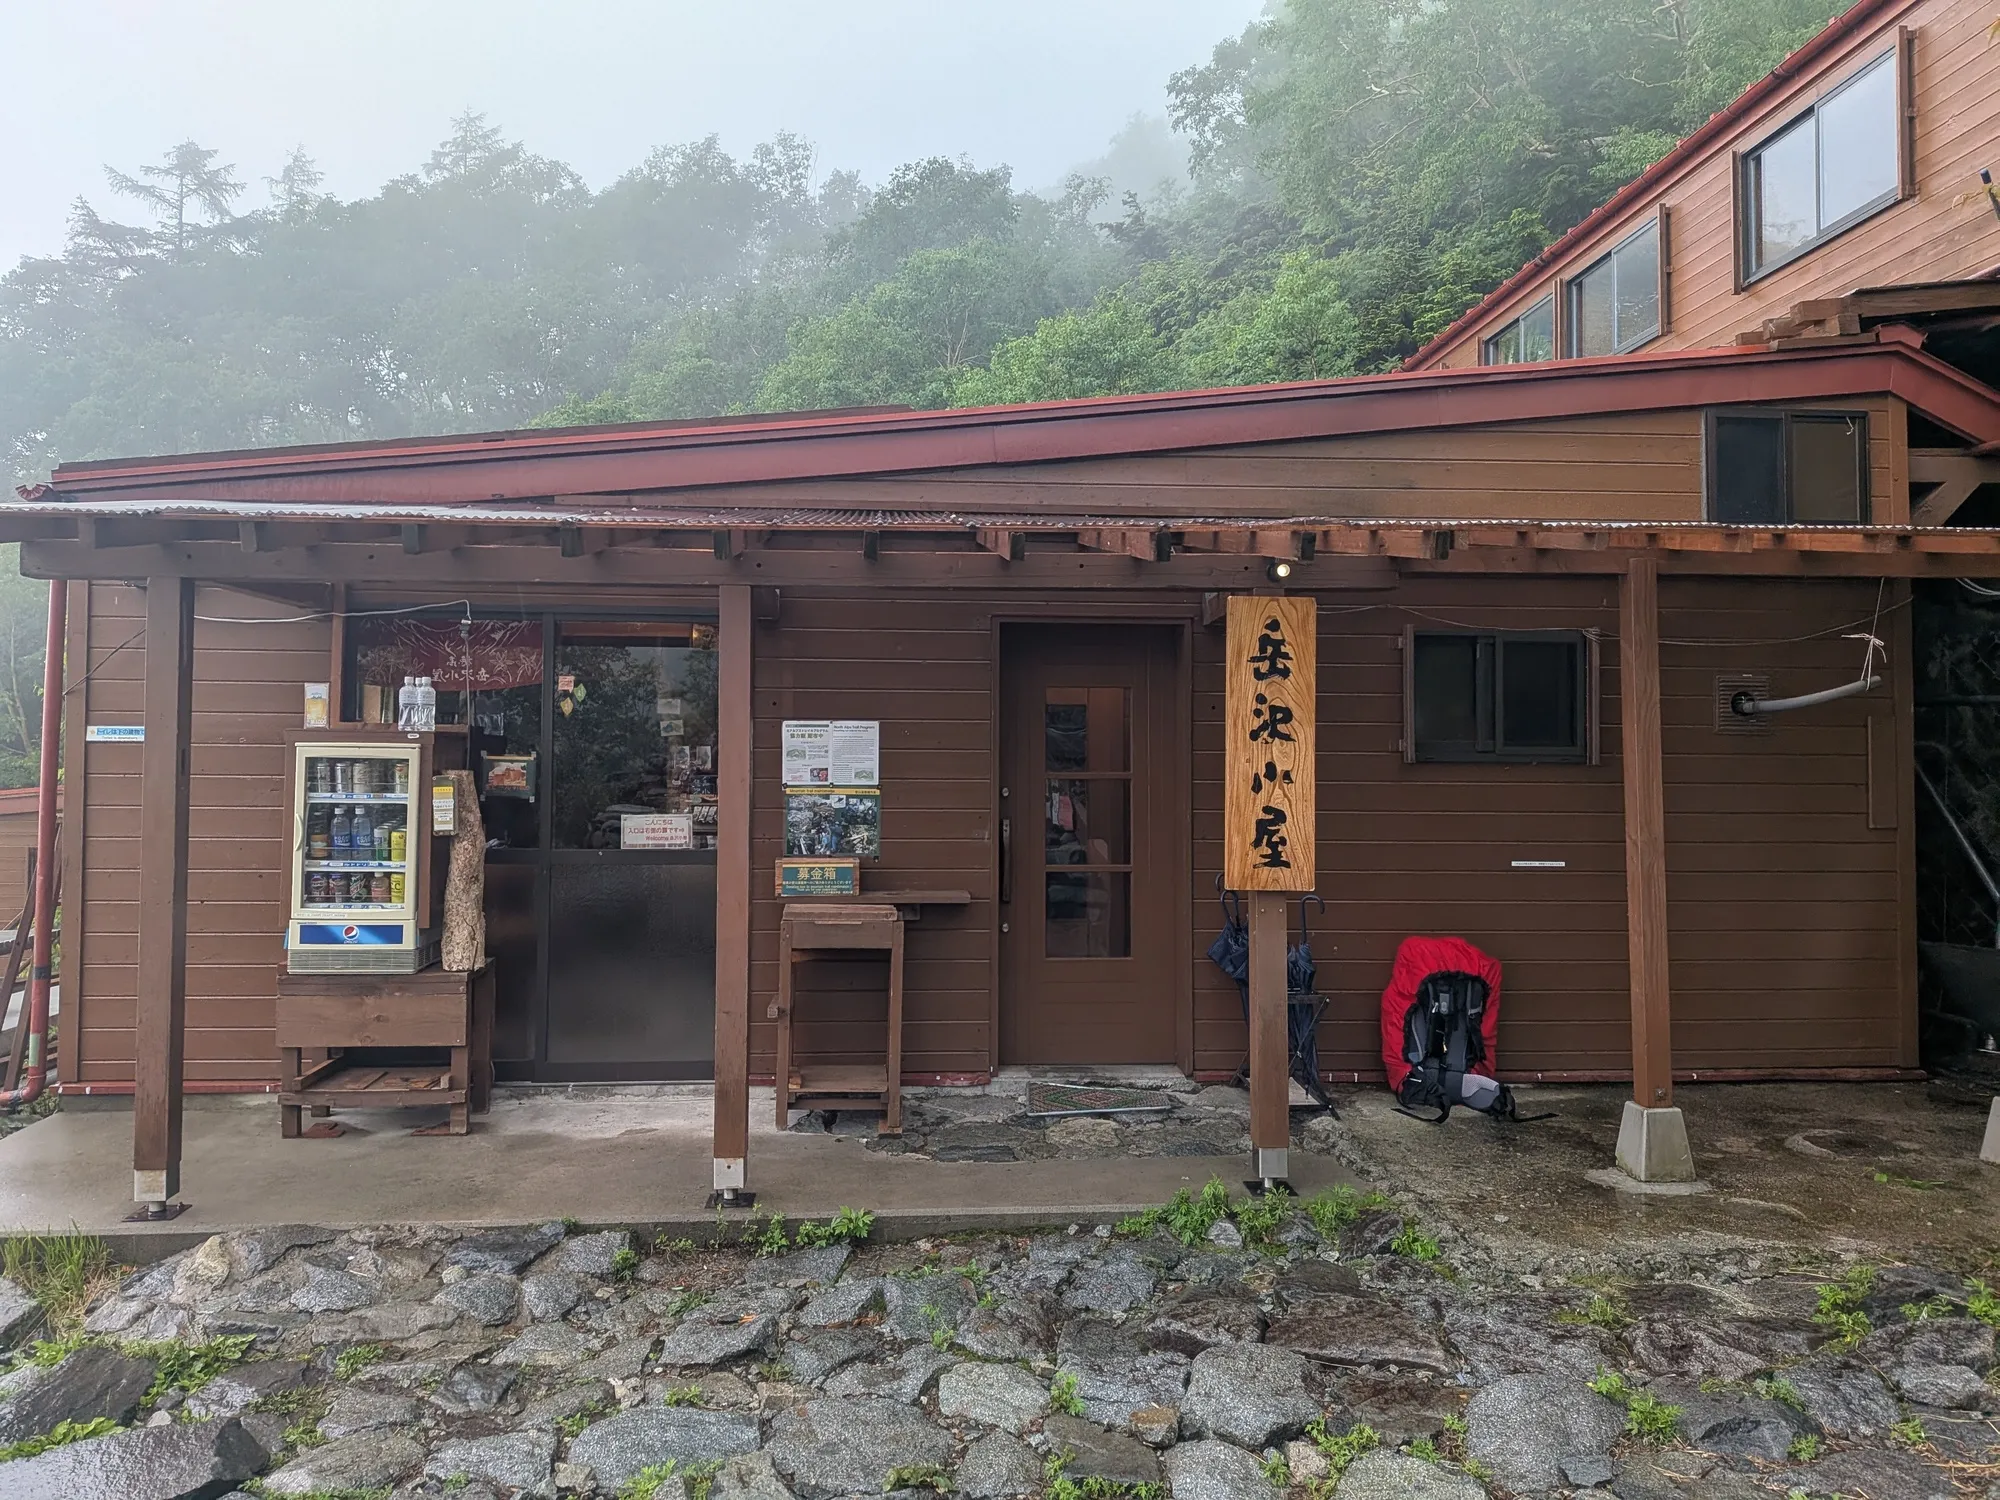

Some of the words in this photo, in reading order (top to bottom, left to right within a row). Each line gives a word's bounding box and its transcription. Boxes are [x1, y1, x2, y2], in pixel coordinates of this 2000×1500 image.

[1247, 618, 1297, 869] 岳沢小屋
[797, 867, 836, 880] 募金箱
